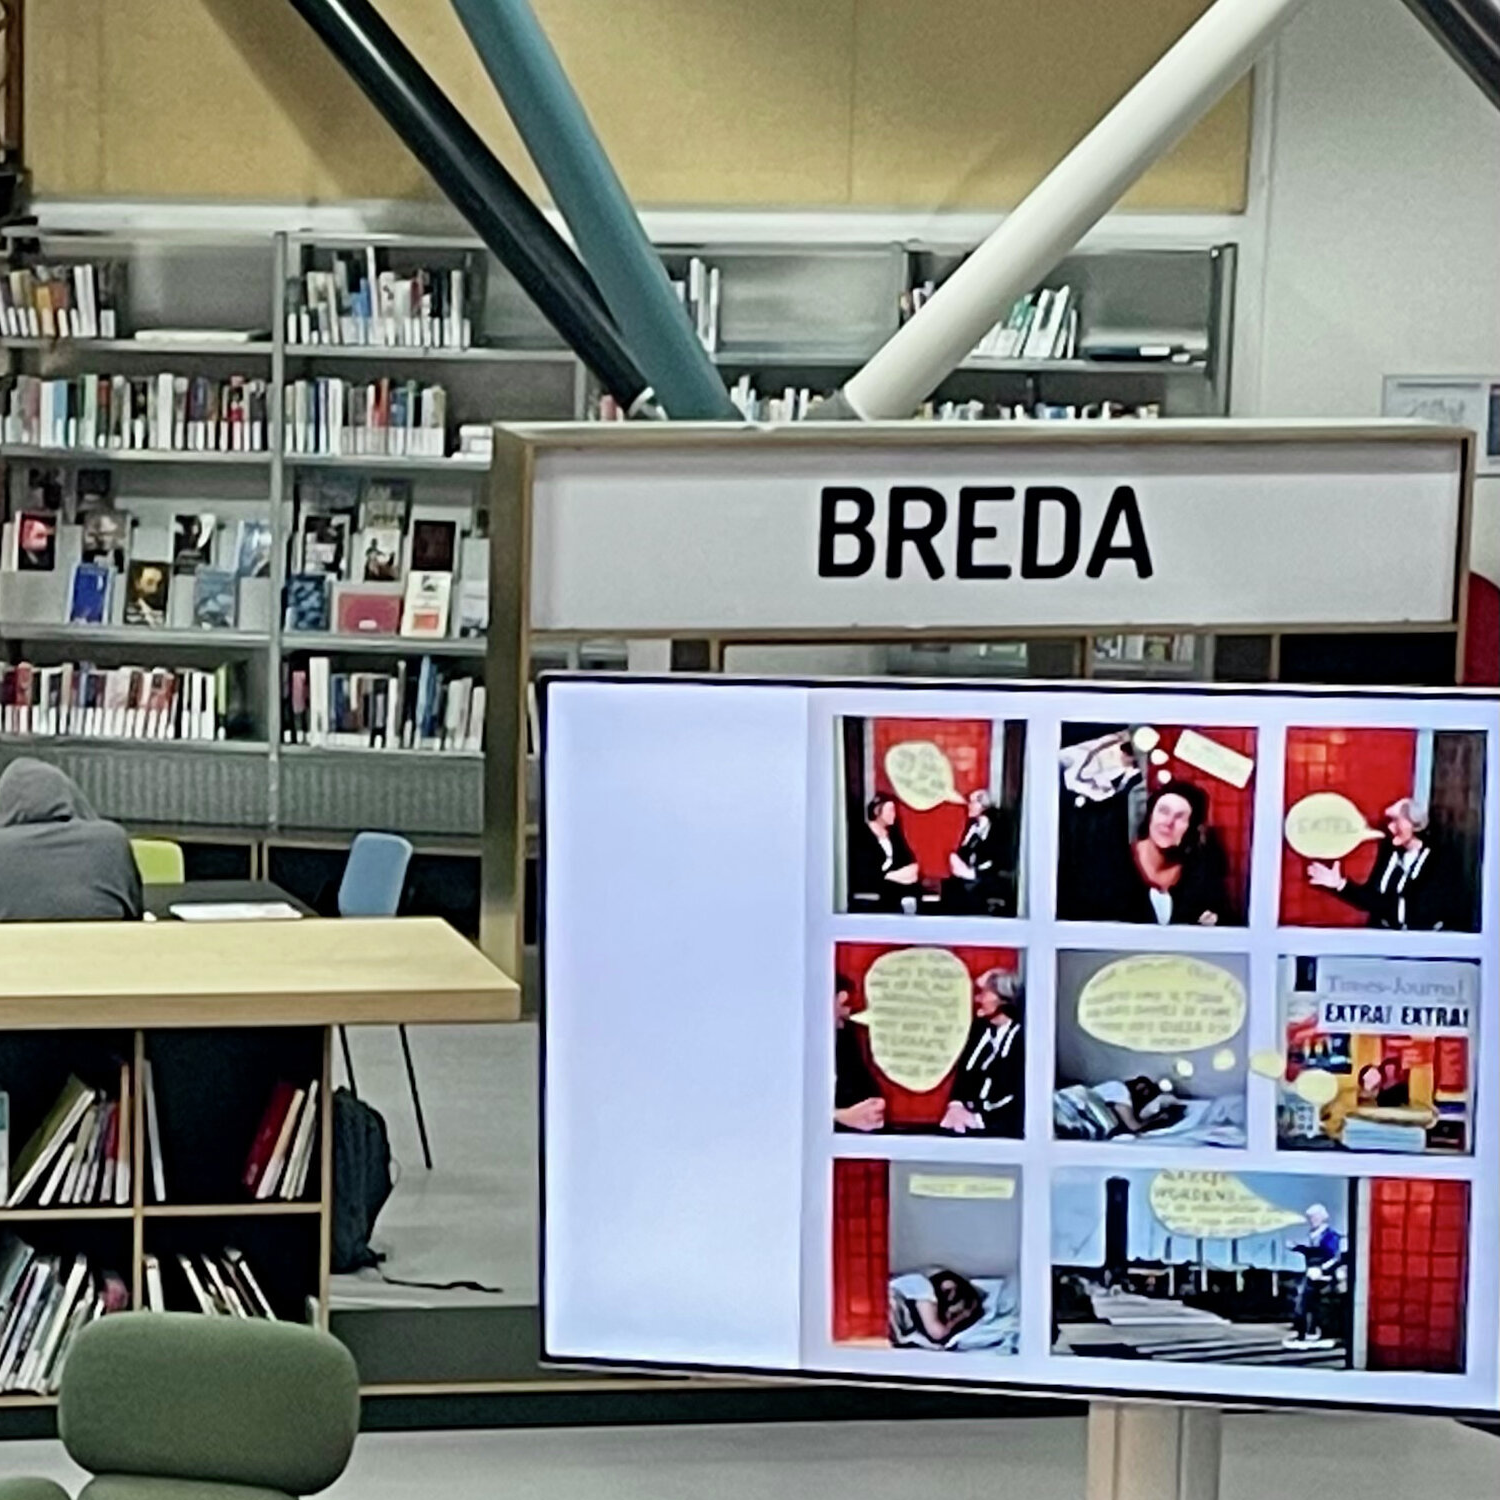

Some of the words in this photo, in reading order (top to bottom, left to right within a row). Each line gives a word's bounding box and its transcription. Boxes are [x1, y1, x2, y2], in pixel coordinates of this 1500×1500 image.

[817, 485, 1154, 580] BREDA
[1325, 1003, 1393, 1024] EXTRA!
[1401, 1006, 1469, 1027] EXTRA!
